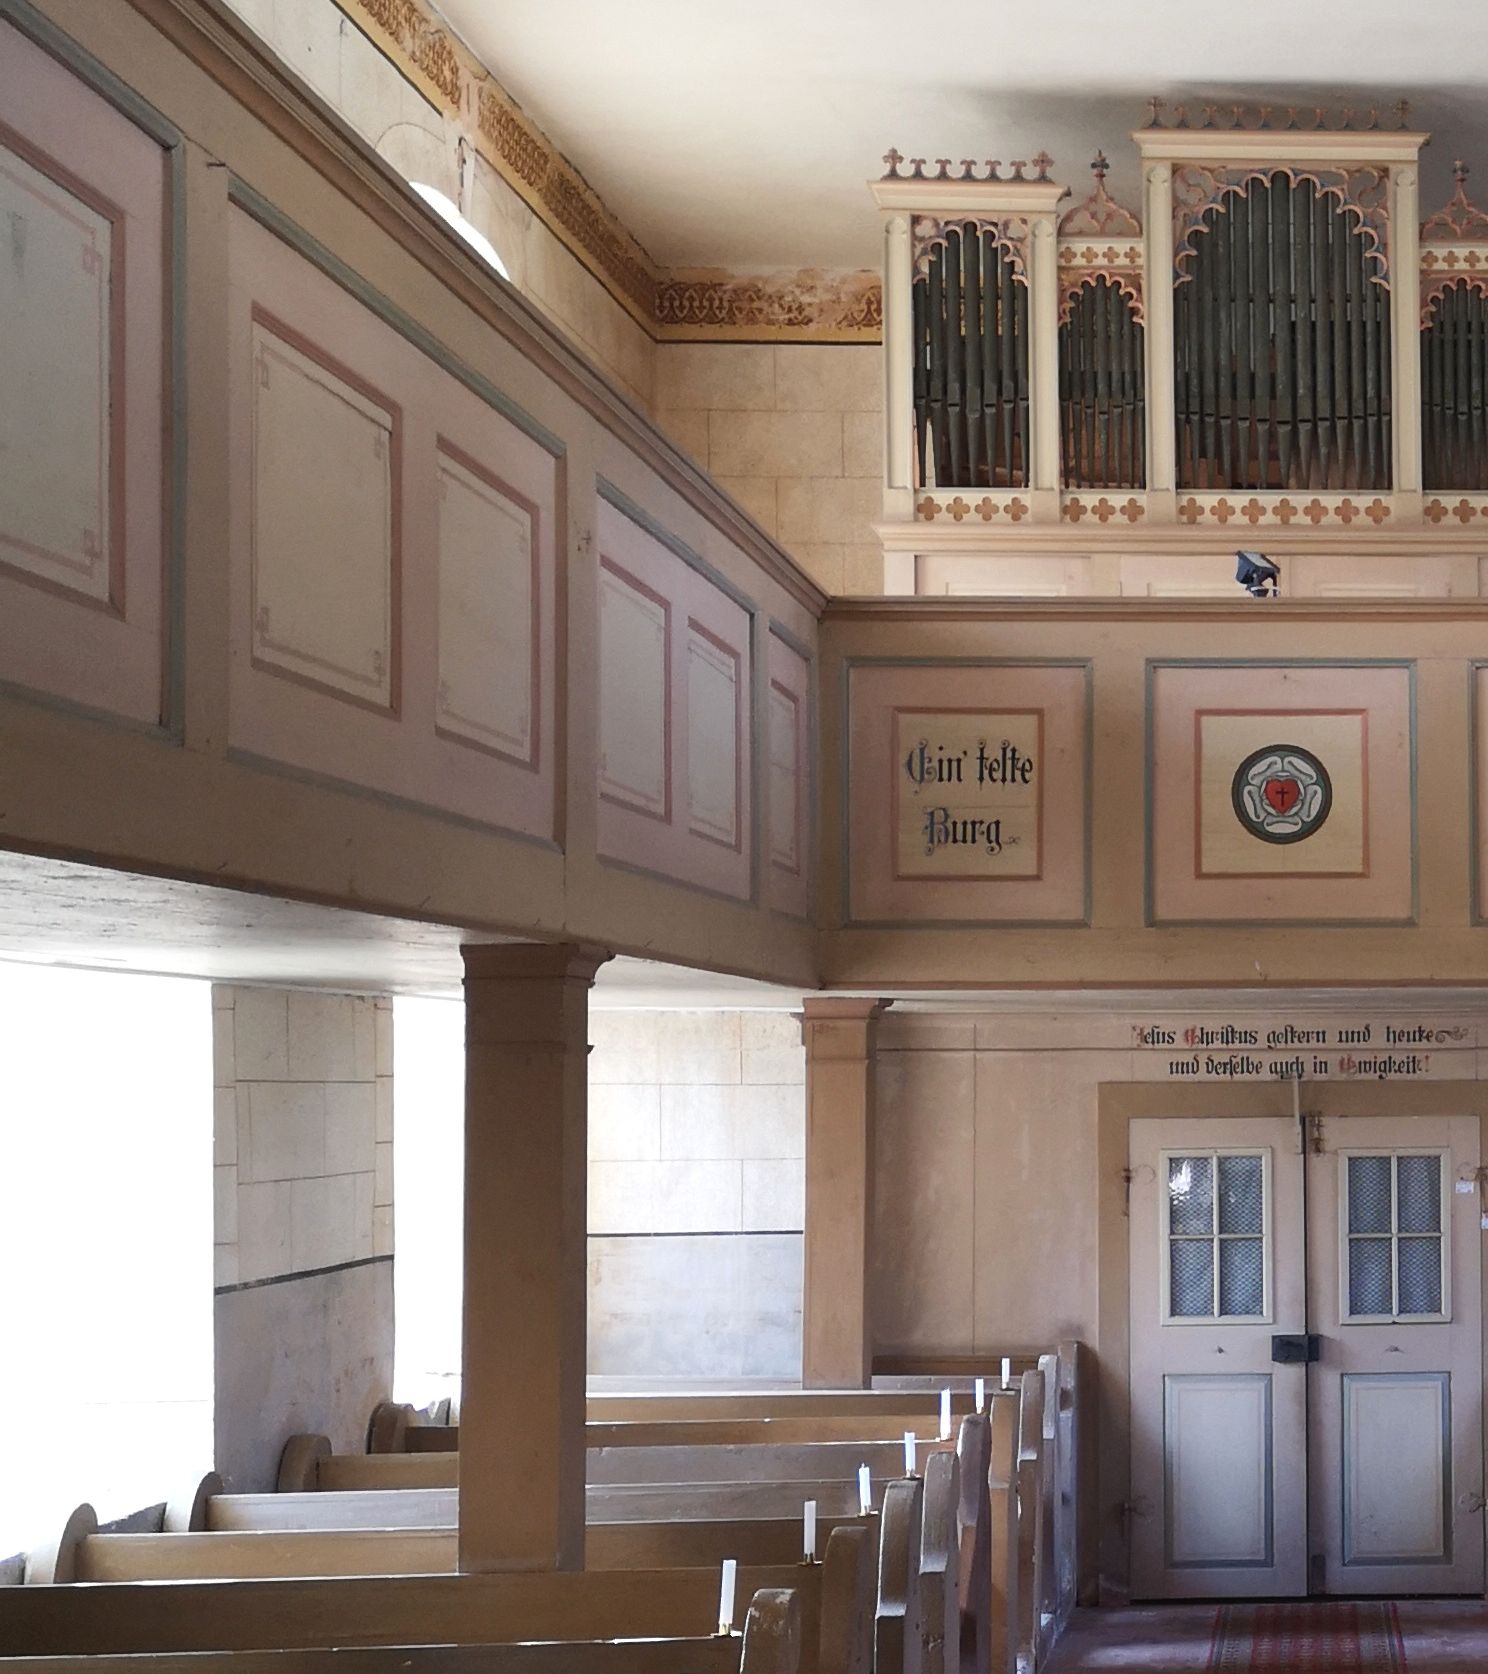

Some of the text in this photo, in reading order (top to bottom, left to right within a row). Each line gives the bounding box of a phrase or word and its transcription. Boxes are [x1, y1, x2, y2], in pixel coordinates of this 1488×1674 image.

[923, 807, 1003, 856] Burg
[1132, 1024, 1434, 1049] Jesus Christus gestern und heute
[1169, 1053, 1200, 1075] und
[1205, 1053, 1263, 1080] derselbe
[1269, 1055, 1304, 1080] auch
[1312, 1055, 1328, 1075] in
